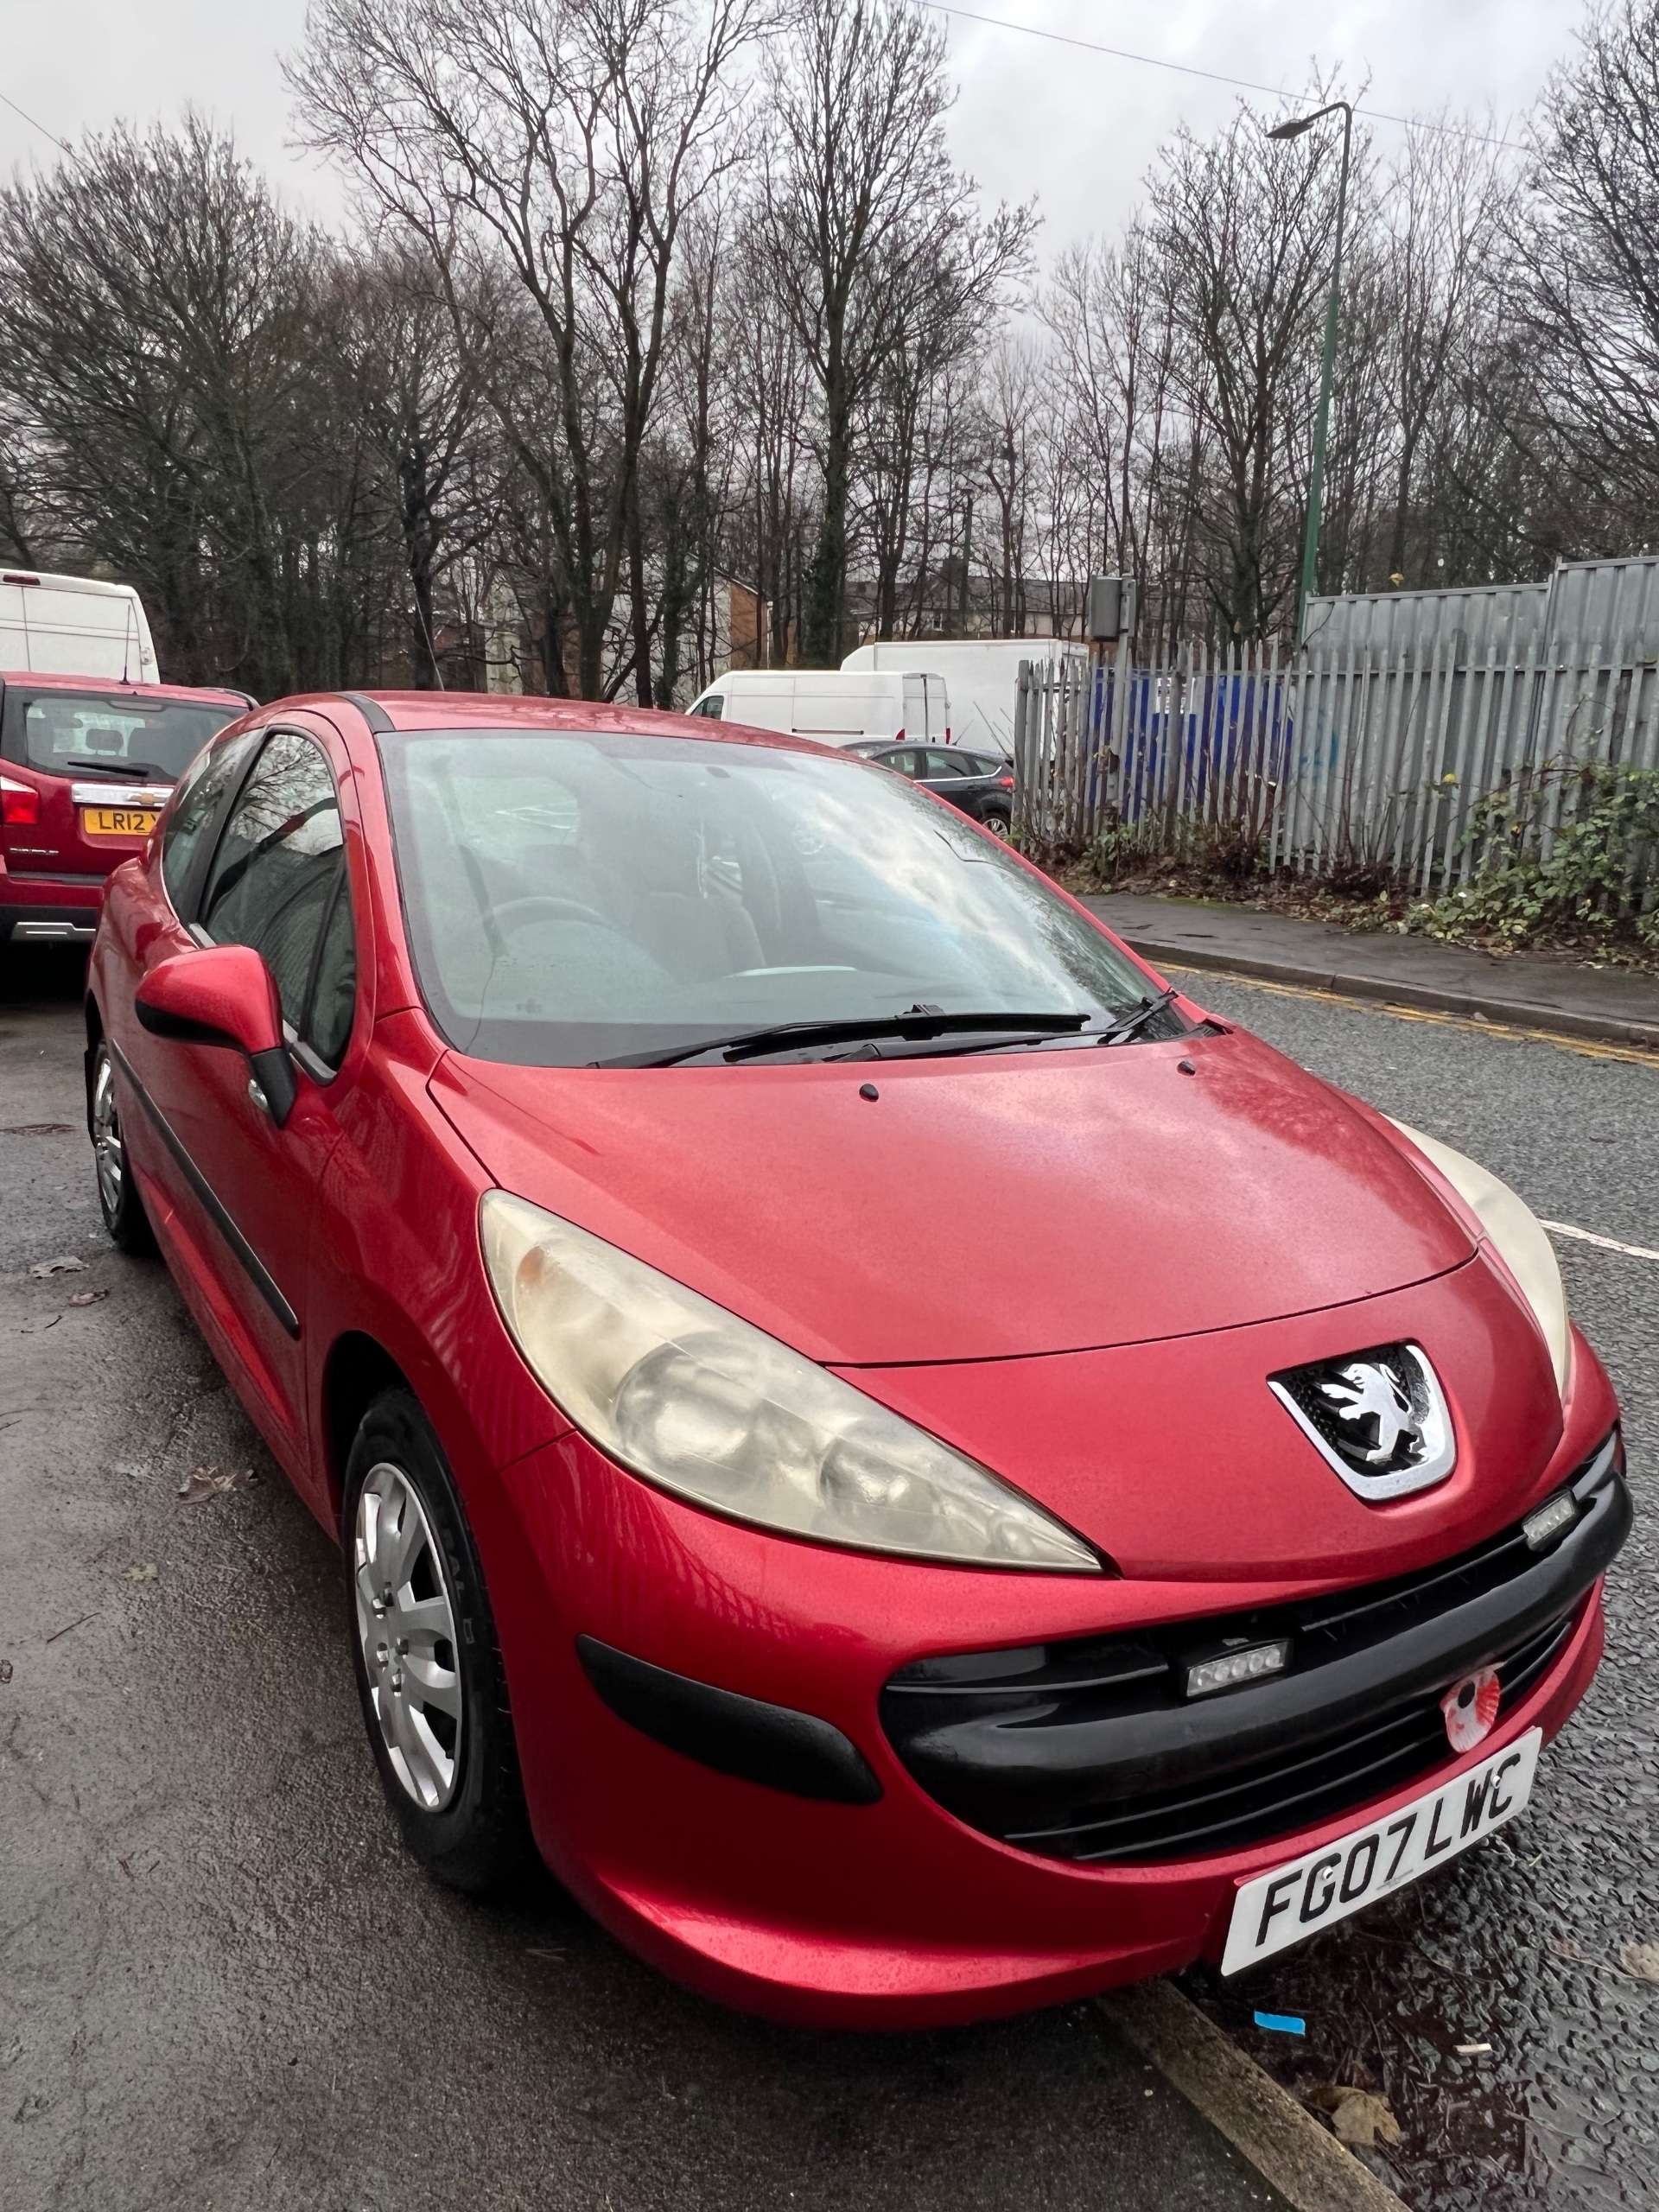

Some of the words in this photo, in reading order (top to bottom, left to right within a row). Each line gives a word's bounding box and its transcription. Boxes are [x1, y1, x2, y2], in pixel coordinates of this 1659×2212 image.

[98, 811, 146, 830] LR12
[1255, 1811, 1419, 1948] FG07
[1423, 1752, 1522, 1861] LWC
